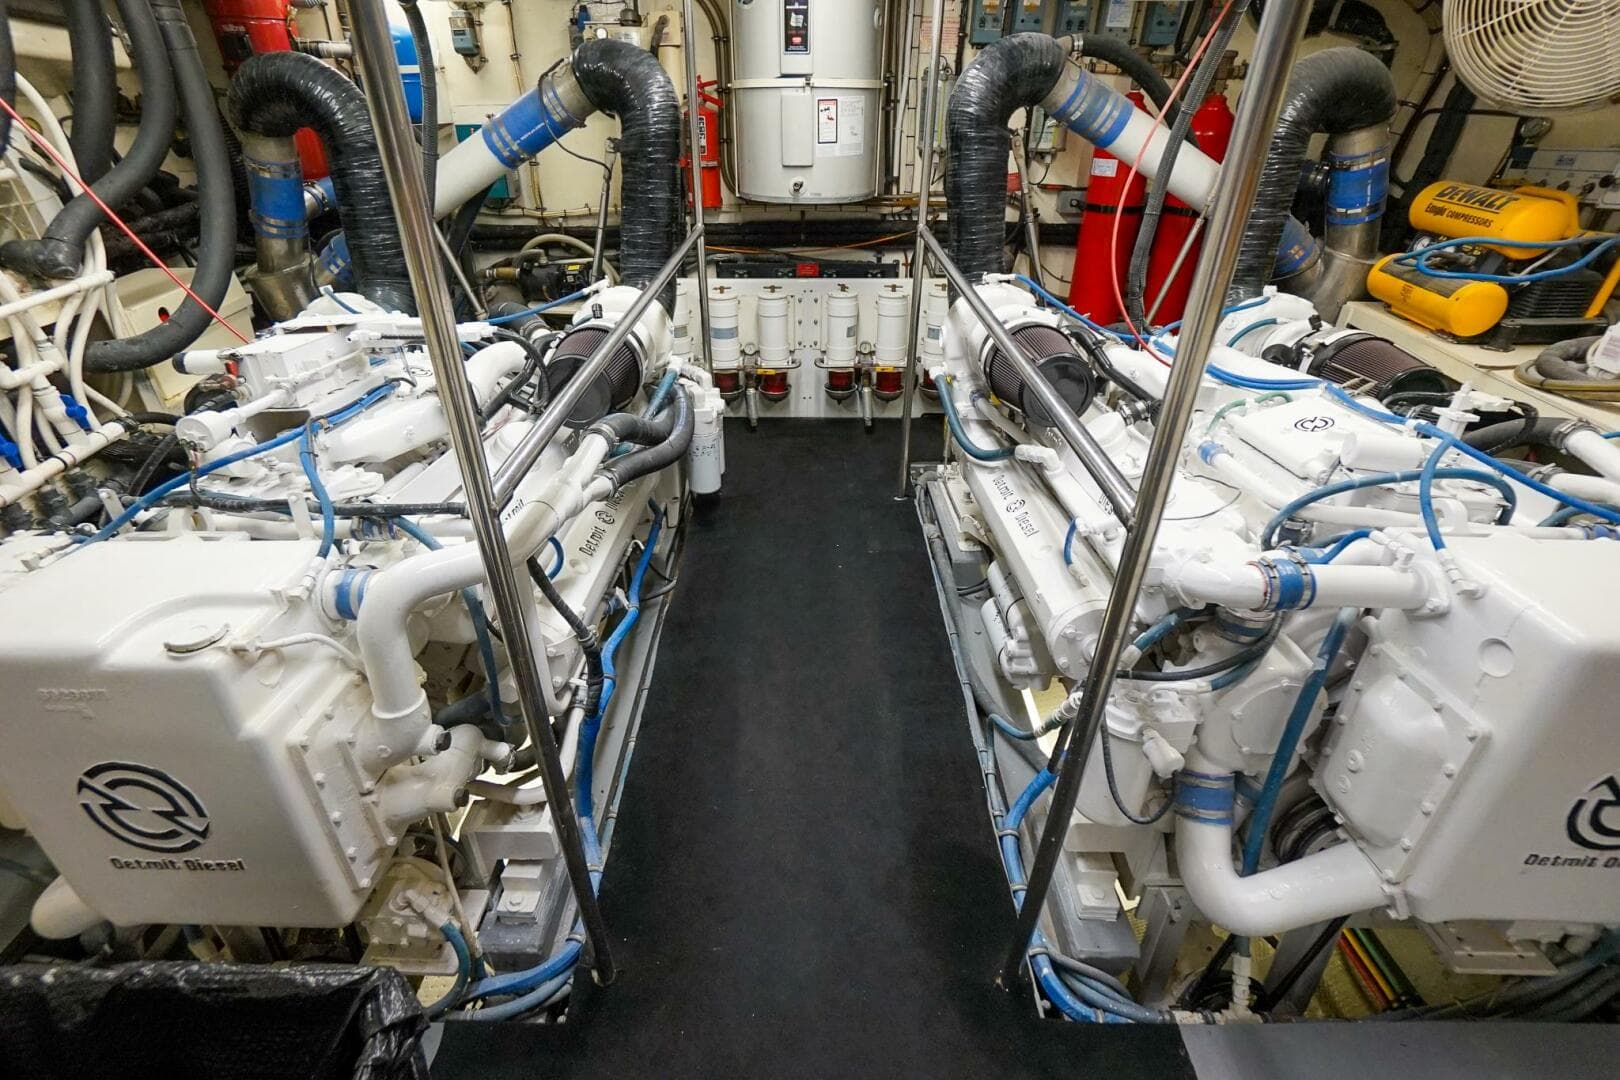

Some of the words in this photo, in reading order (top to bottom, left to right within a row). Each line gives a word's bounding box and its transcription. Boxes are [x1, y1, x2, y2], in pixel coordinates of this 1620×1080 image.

[1446, 209, 1494, 228] COMPRESSORS
[992, 474, 1014, 500] Detroit
[1015, 511, 1040, 538] Diesel
[578, 526, 607, 557] Detroit
[109, 857, 180, 871] Detroit
[183, 858, 246, 872] Diesel
[1523, 853, 1598, 868] Detroit
